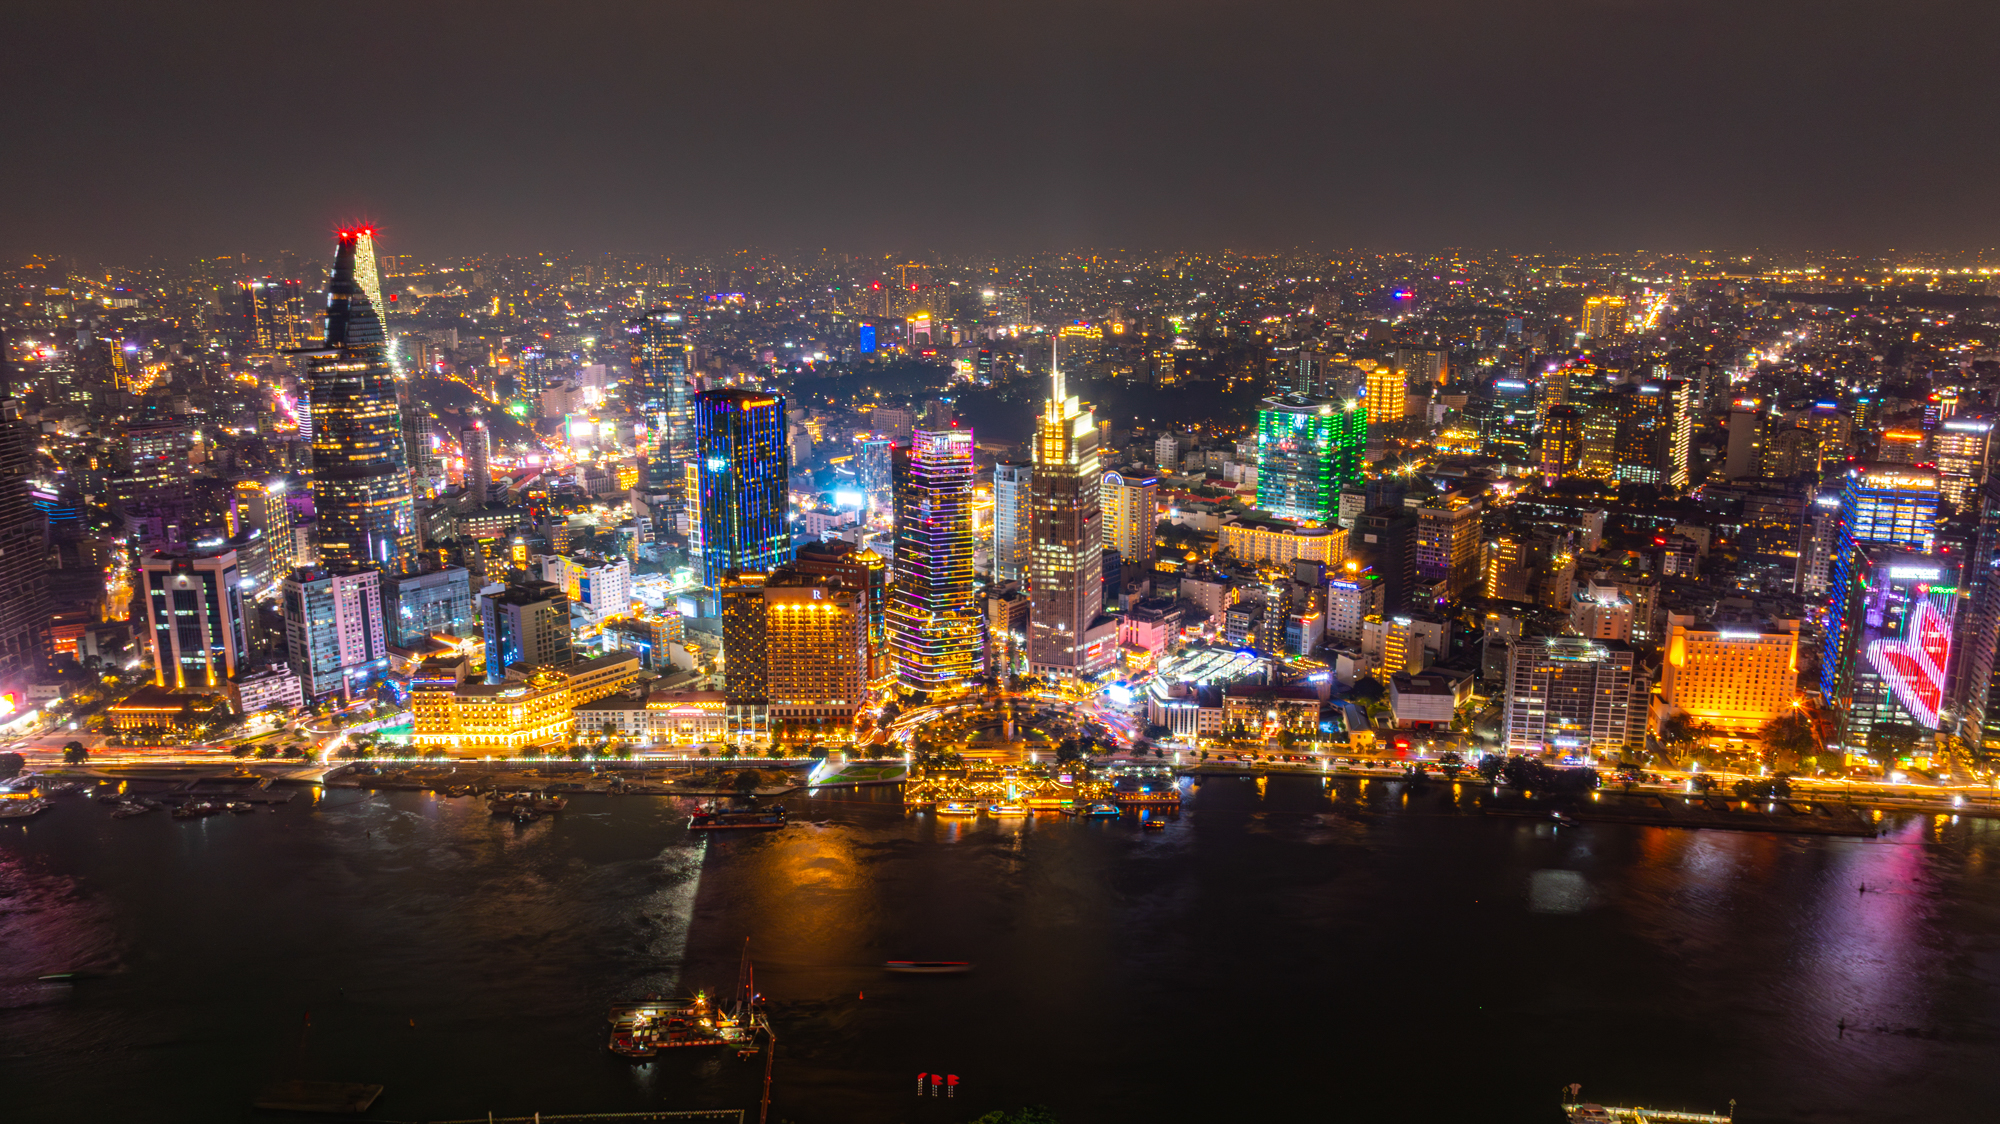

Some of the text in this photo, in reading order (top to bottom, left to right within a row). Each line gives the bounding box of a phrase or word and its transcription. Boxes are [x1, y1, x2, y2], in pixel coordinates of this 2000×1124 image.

[948, 434, 971, 442] Hilton
[1868, 476, 1892, 484] THE
[1928, 586, 1958, 594] VPBank
[812, 590, 822, 599] R
